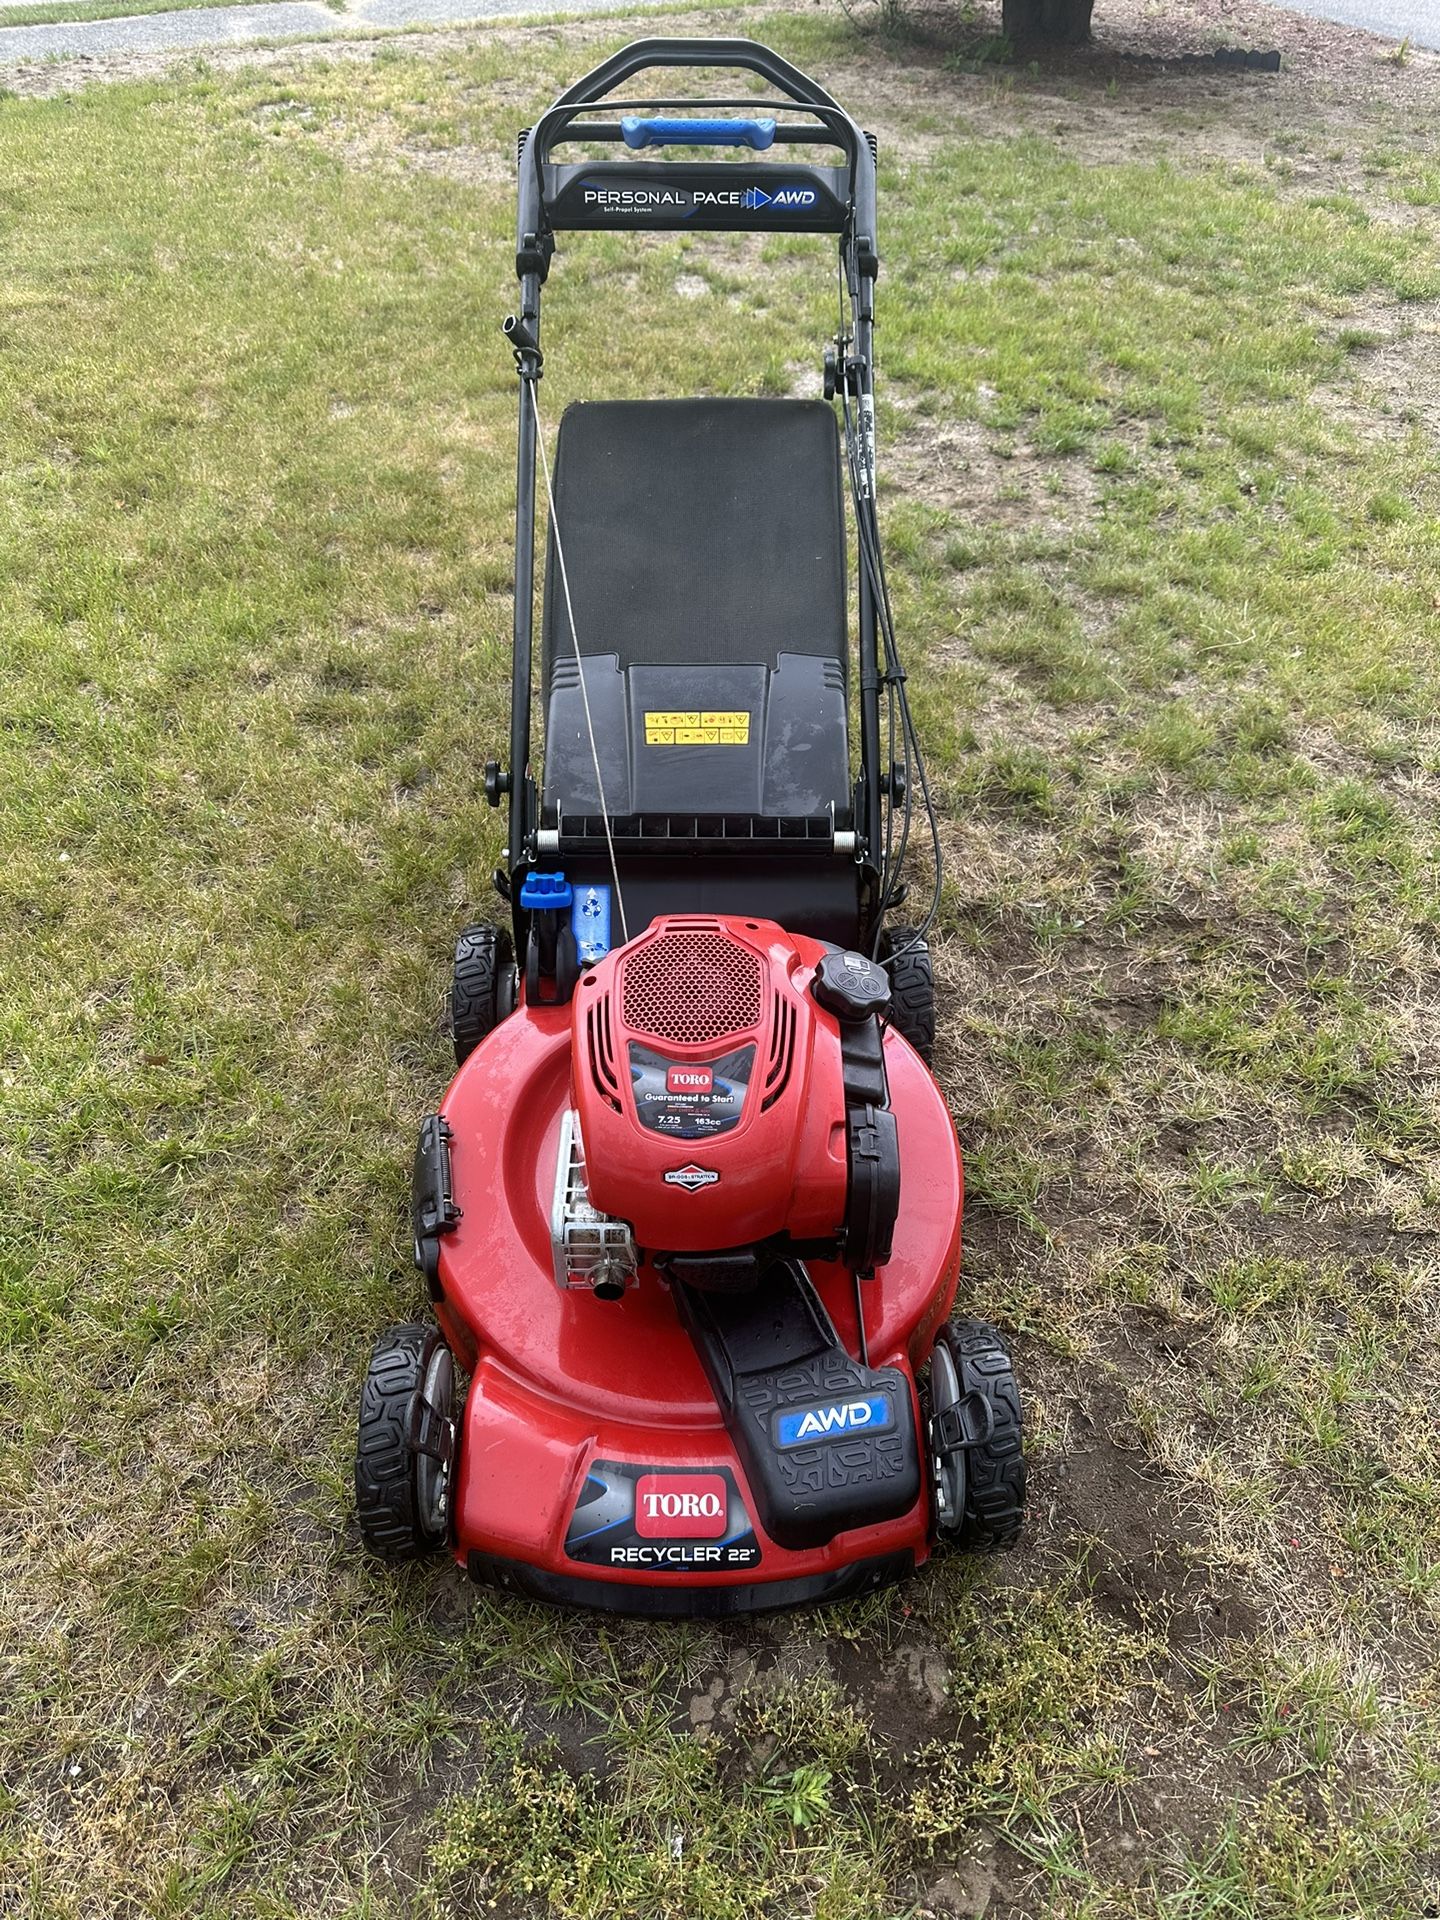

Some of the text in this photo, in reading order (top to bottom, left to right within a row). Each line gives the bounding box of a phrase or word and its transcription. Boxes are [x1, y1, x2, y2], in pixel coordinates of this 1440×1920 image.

[584, 191, 686, 204] PERSONAL
[772, 191, 815, 204] AWD
[671, 1073, 710, 1085] TORO
[645, 1093, 734, 1103] Guaranteed to Start
[657, 1115, 681, 1124] 7.25
[695, 1117, 721, 1126] 163cc
[796, 1402, 872, 1438] AWD
